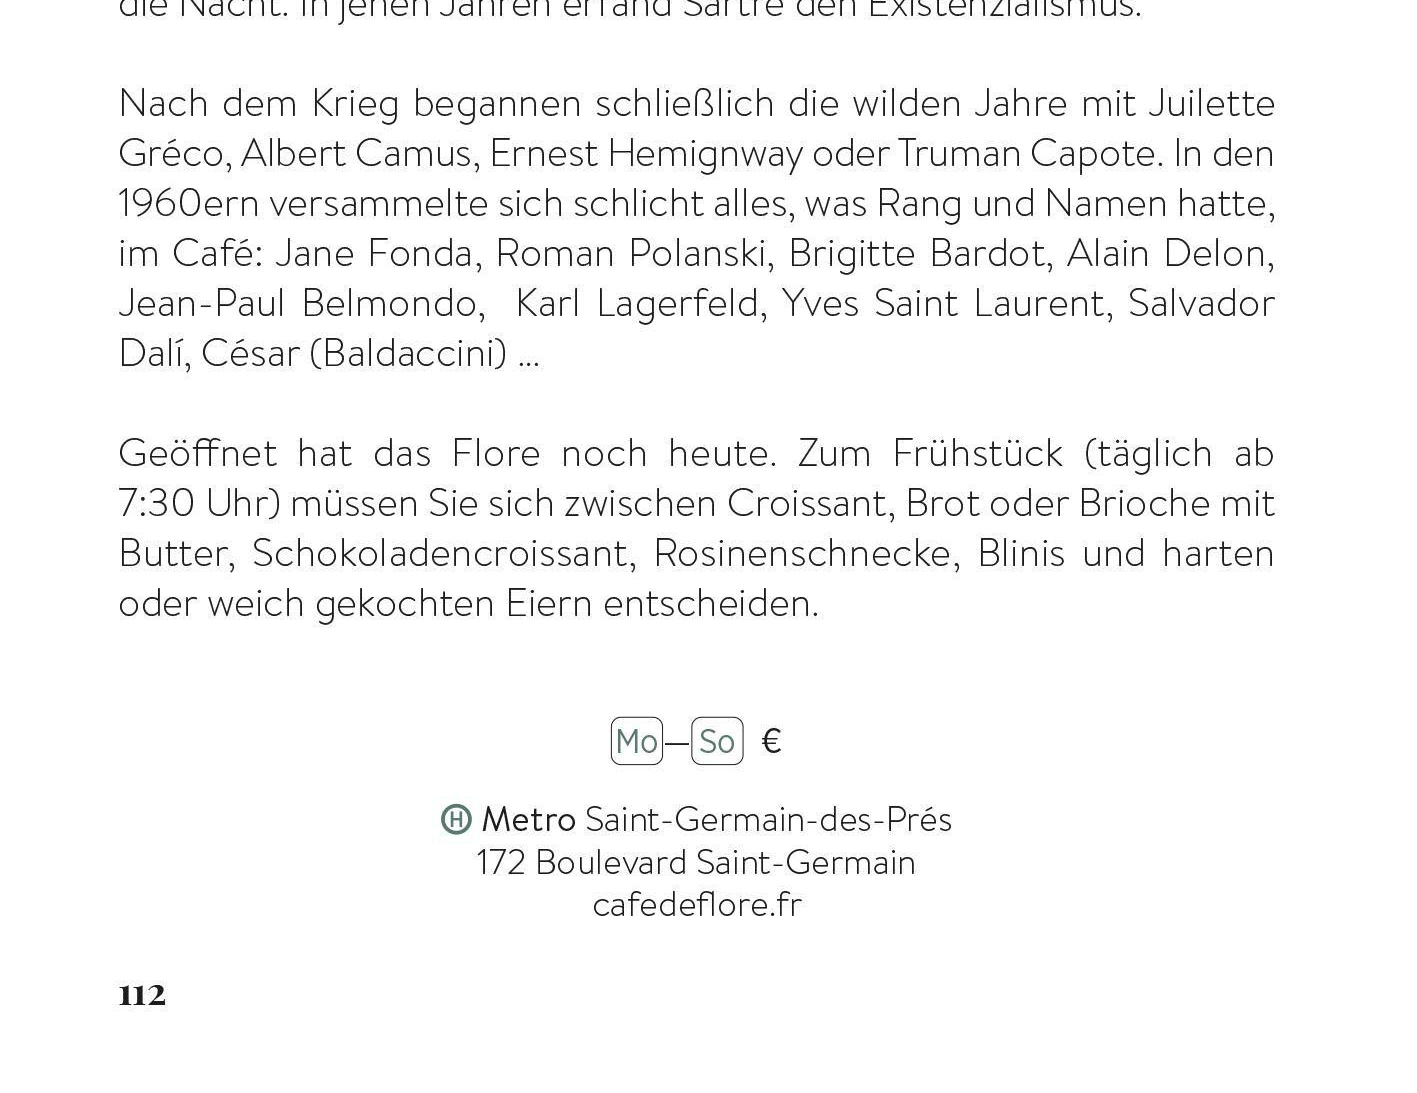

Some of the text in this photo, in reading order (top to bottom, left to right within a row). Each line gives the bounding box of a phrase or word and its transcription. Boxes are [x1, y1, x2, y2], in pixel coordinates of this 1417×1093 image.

[121, 87, 1275, 126] Nach dem Krieg begannen schließlich die wilden Jahre mit Juilette
[119, 137, 1273, 176] Gréco, Albert Camus, Ernest Hemignway oder Truman Capote. In den
[119, 237, 1274, 276] im Café: Jane Fonda, Roman Polanski, Brigitte Bardot, Alain Delon,
[118, 287, 1276, 326] Jean-Paul Belmondo, Karl Lagerfeld, Yves Saint Laurent, Salvador
[121, 337, 506, 374] Dalí, César (Baldaccini)
[121, 537, 1273, 574] Butter, Schokoladencroissant, Rosinenschnecke, Blinis und harten
[119, 587, 818, 626] oder weich gekochten Eiern entscheiden.
[617, 727, 782, 754] Mo So €
[481, 805, 576, 832] Metro
[586, 805, 952, 832] Saint-Germain-des-Prés
[477, 848, 915, 875] 172 Boulevard Saint-Germain
[593, 890, 803, 917] cafedeflore.fr
[118, 984, 166, 1006] 112
